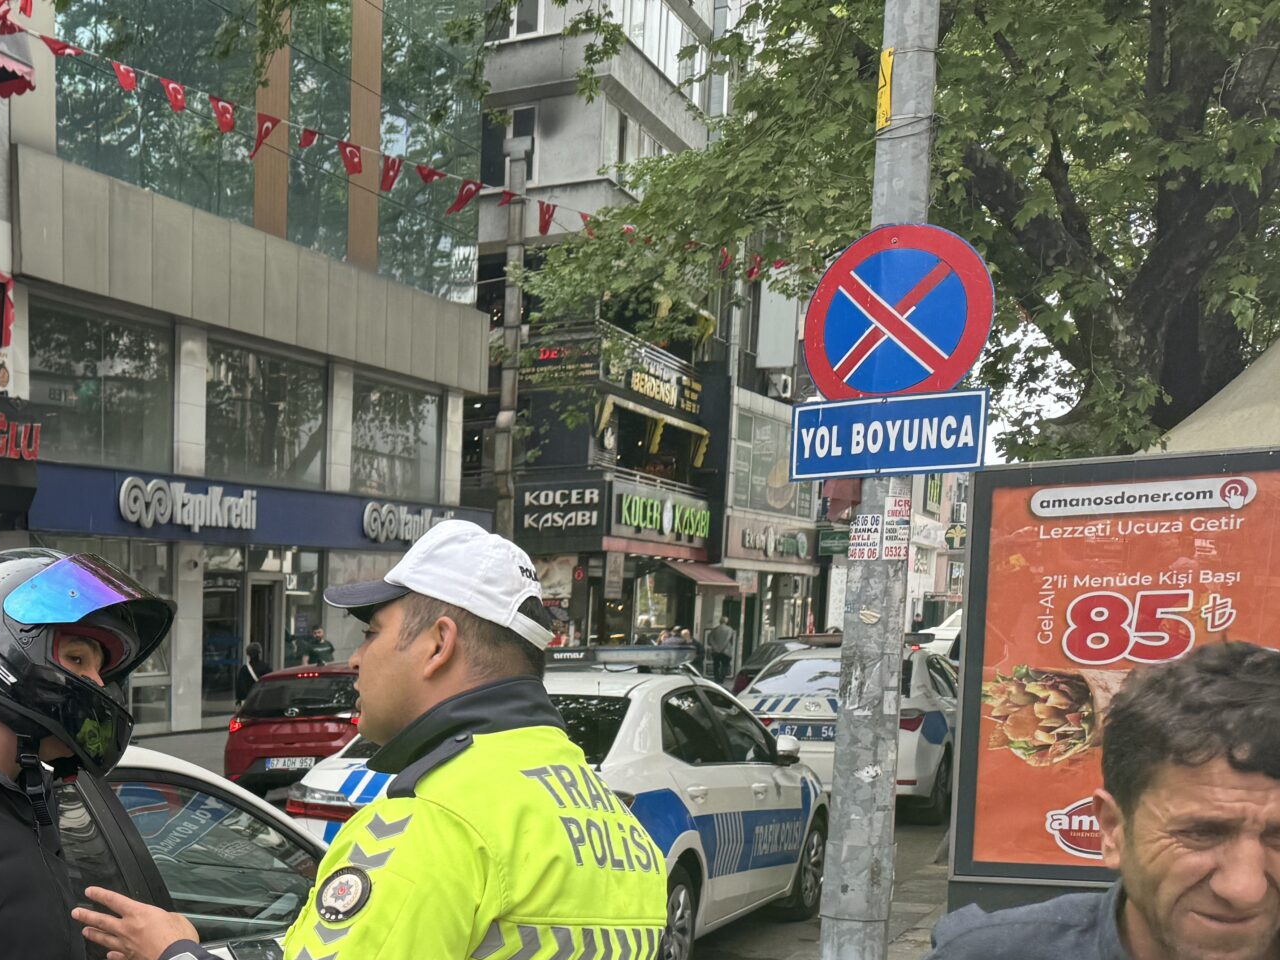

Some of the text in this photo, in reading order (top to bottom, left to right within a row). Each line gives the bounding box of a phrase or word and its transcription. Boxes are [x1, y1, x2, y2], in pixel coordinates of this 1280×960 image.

[801, 415, 974, 458] YOL BOYUNCA
[524, 488, 599, 507] KOÇER
[1039, 489, 1214, 509] amanosdoner.com
[524, 510, 598, 532] KASABI
[674, 504, 709, 538] KASABI
[1039, 514, 1245, 539] Lezzeti Ucuza Getir
[1073, 571, 1153, 587] Menüde
[1158, 570, 1193, 589] Kişi
[1199, 569, 1241, 587] Başı
[1037, 591, 1055, 645] Gel-Al
[1062, 589, 1195, 665] 85
[806, 725, 812, 737] A
